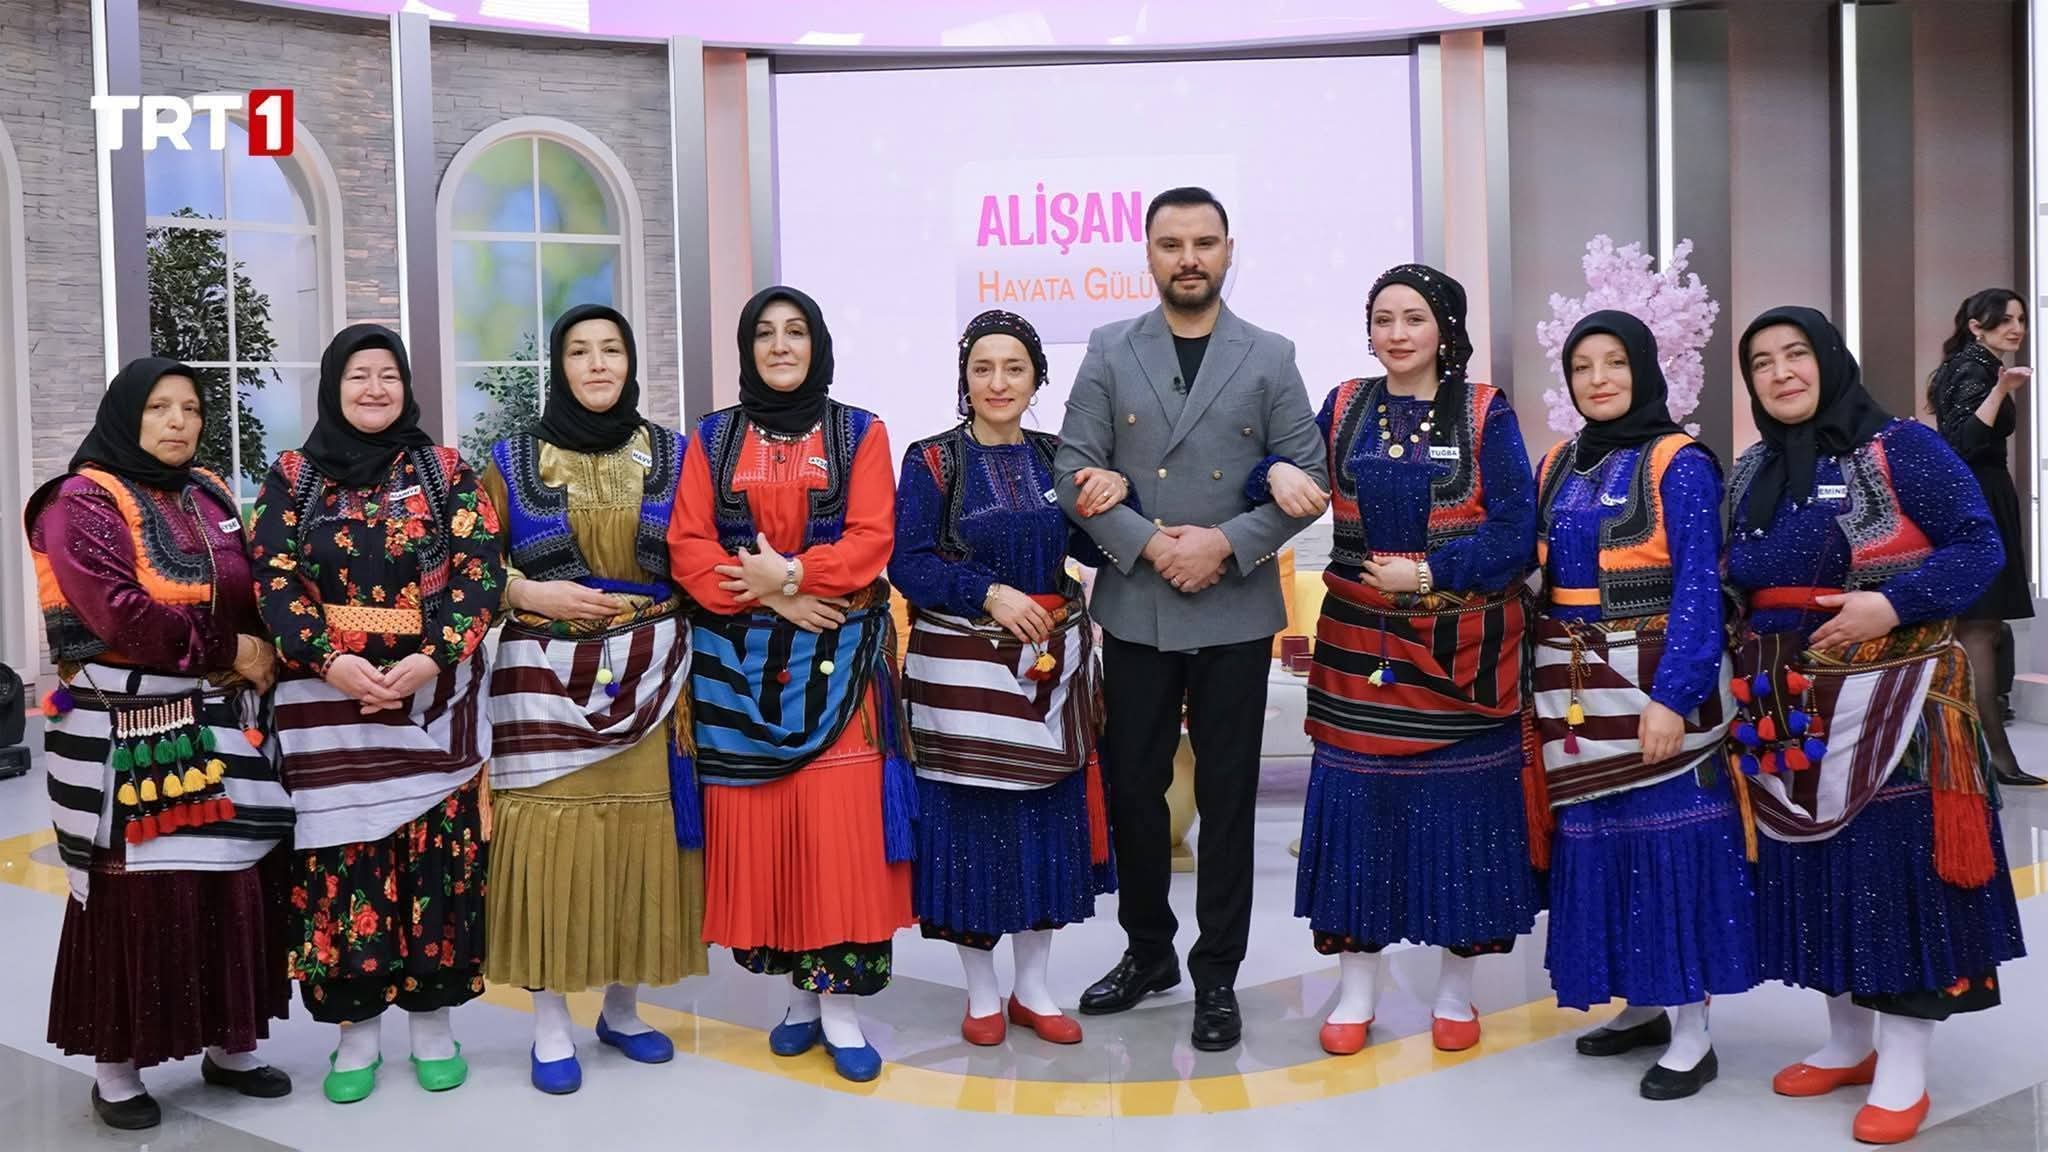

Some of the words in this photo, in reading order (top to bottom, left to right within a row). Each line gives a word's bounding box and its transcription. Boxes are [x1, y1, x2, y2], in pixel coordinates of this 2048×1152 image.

[977, 182, 1143, 256] ALİŞAN
[978, 270, 1075, 303] HAYATA
[1084, 266, 1160, 301] GÜLÜ
